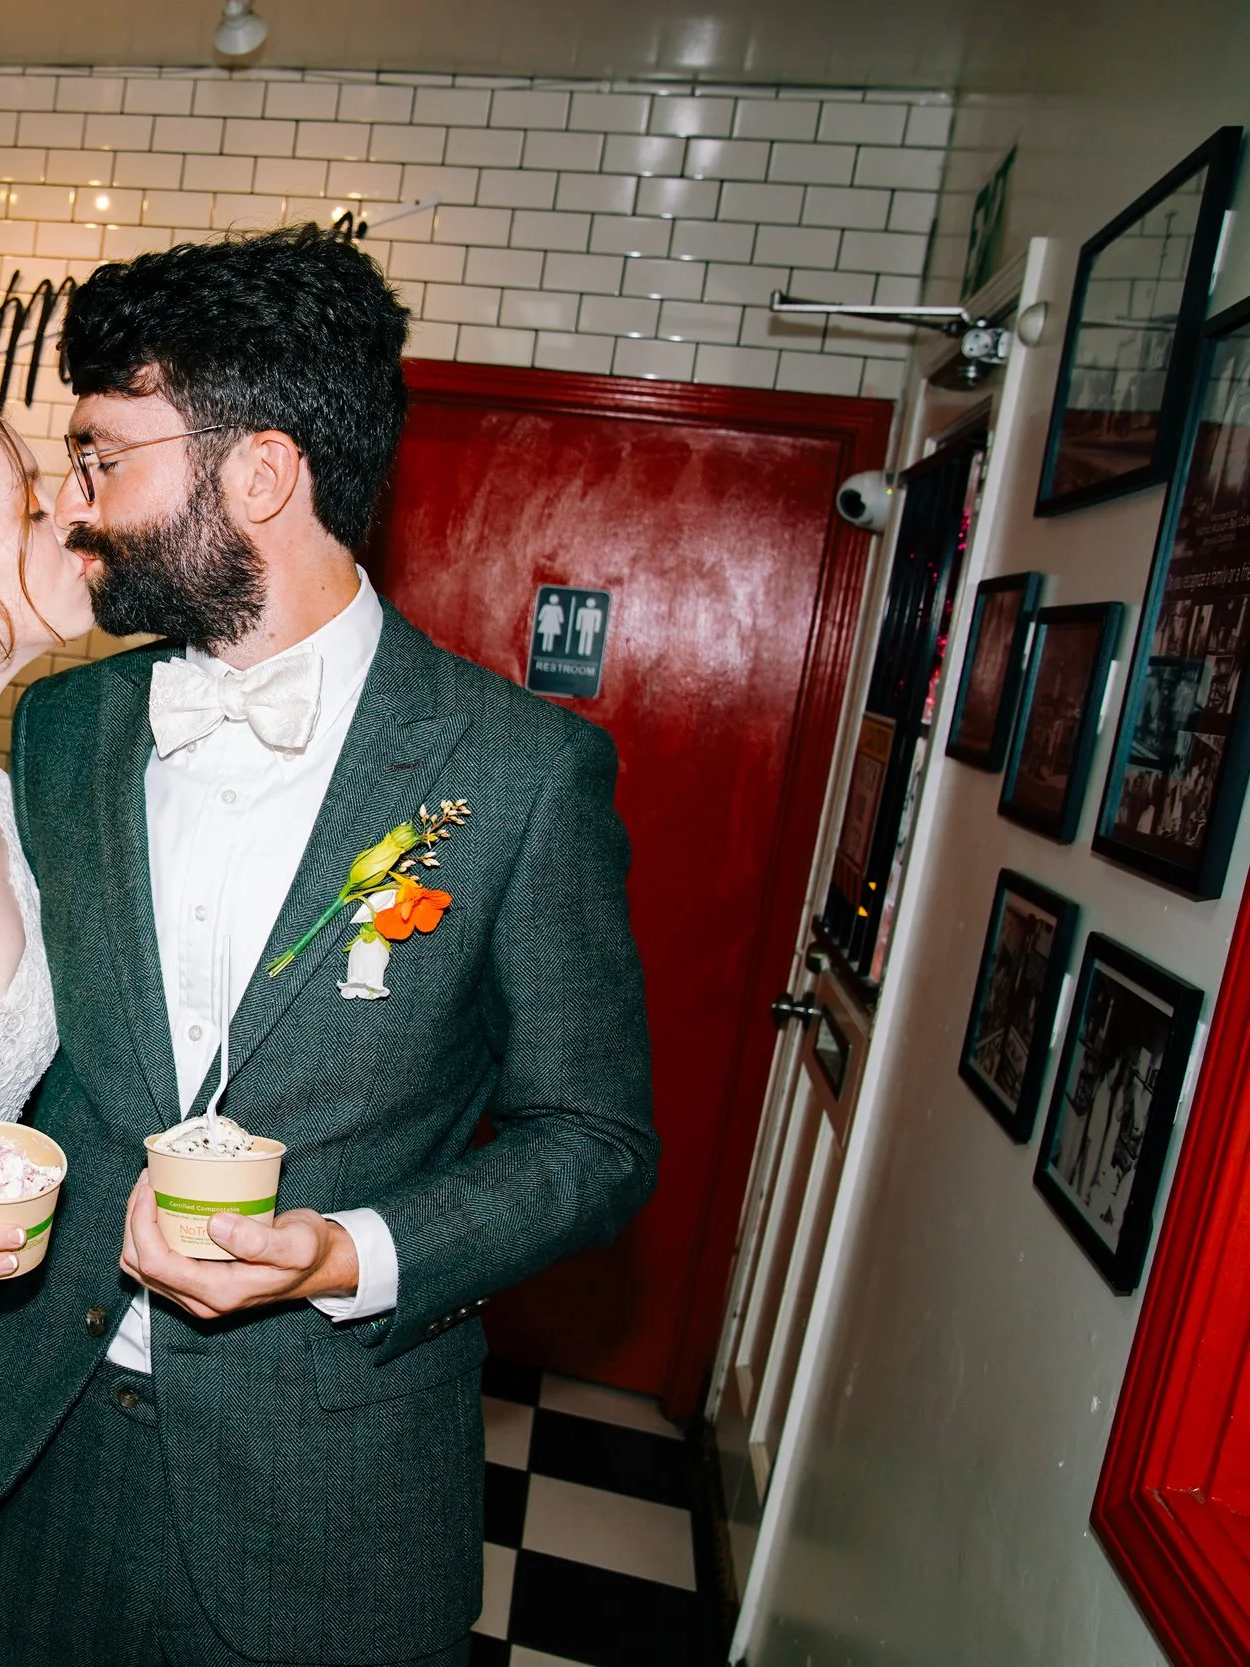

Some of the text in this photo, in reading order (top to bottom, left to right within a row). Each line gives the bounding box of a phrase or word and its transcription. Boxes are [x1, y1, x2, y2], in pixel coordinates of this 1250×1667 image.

[535, 660, 596, 677] RESTROOM
[169, 1201, 240, 1214] Certified Compostable
